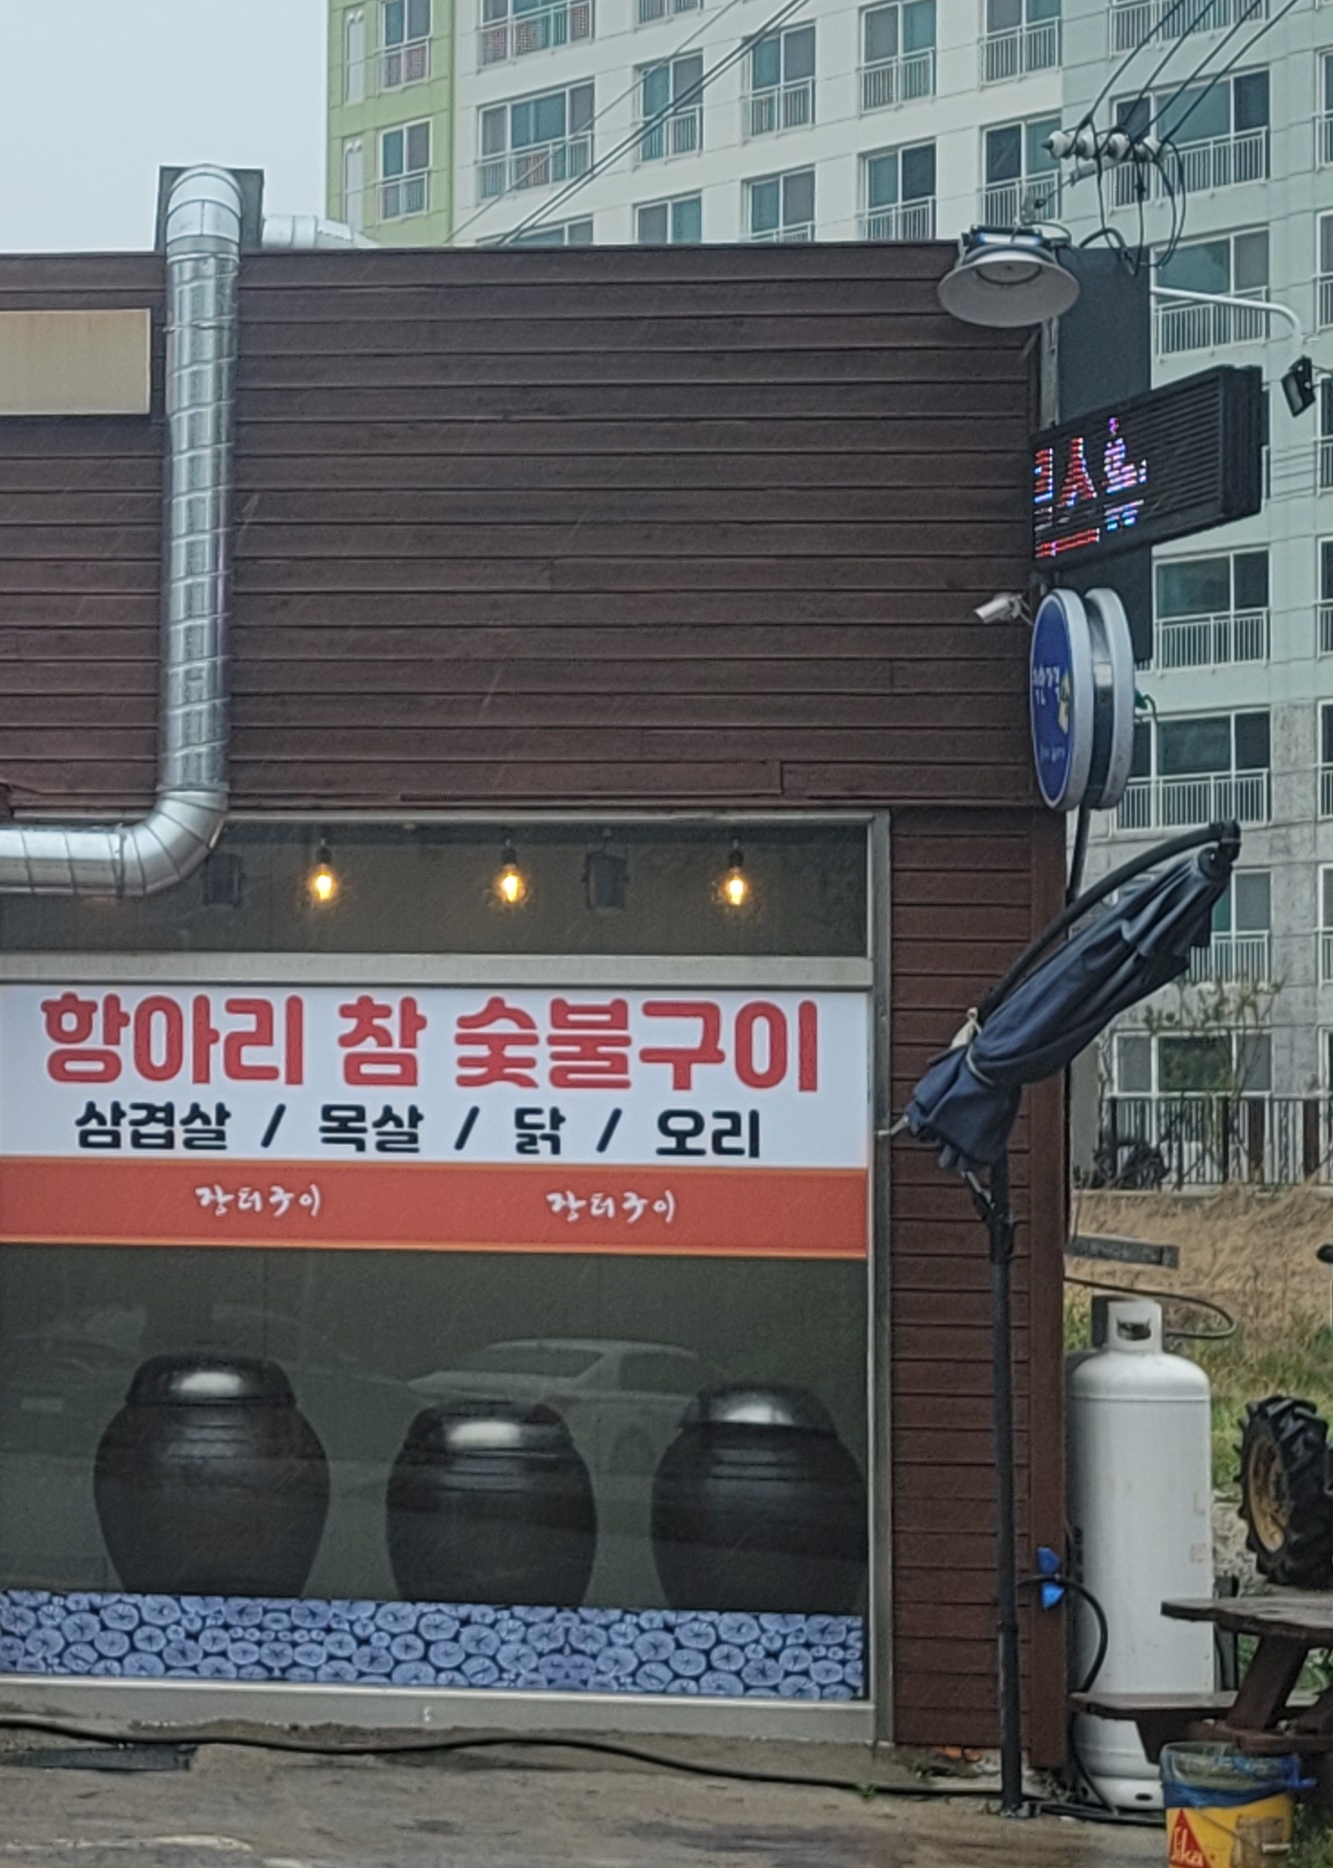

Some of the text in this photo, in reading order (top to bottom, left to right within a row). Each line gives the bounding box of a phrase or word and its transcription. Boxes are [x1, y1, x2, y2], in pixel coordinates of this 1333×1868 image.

[42, 993, 816, 1091] 항아리 참 숯불구이
[75, 1101, 231, 1150] 삼겹살
[319, 1105, 424, 1153] 목살
[515, 1107, 566, 1155] 닭
[656, 1110, 759, 1158] 오리
[196, 1184, 320, 1216] 장터구이
[547, 1190, 674, 1222] 장터구이
